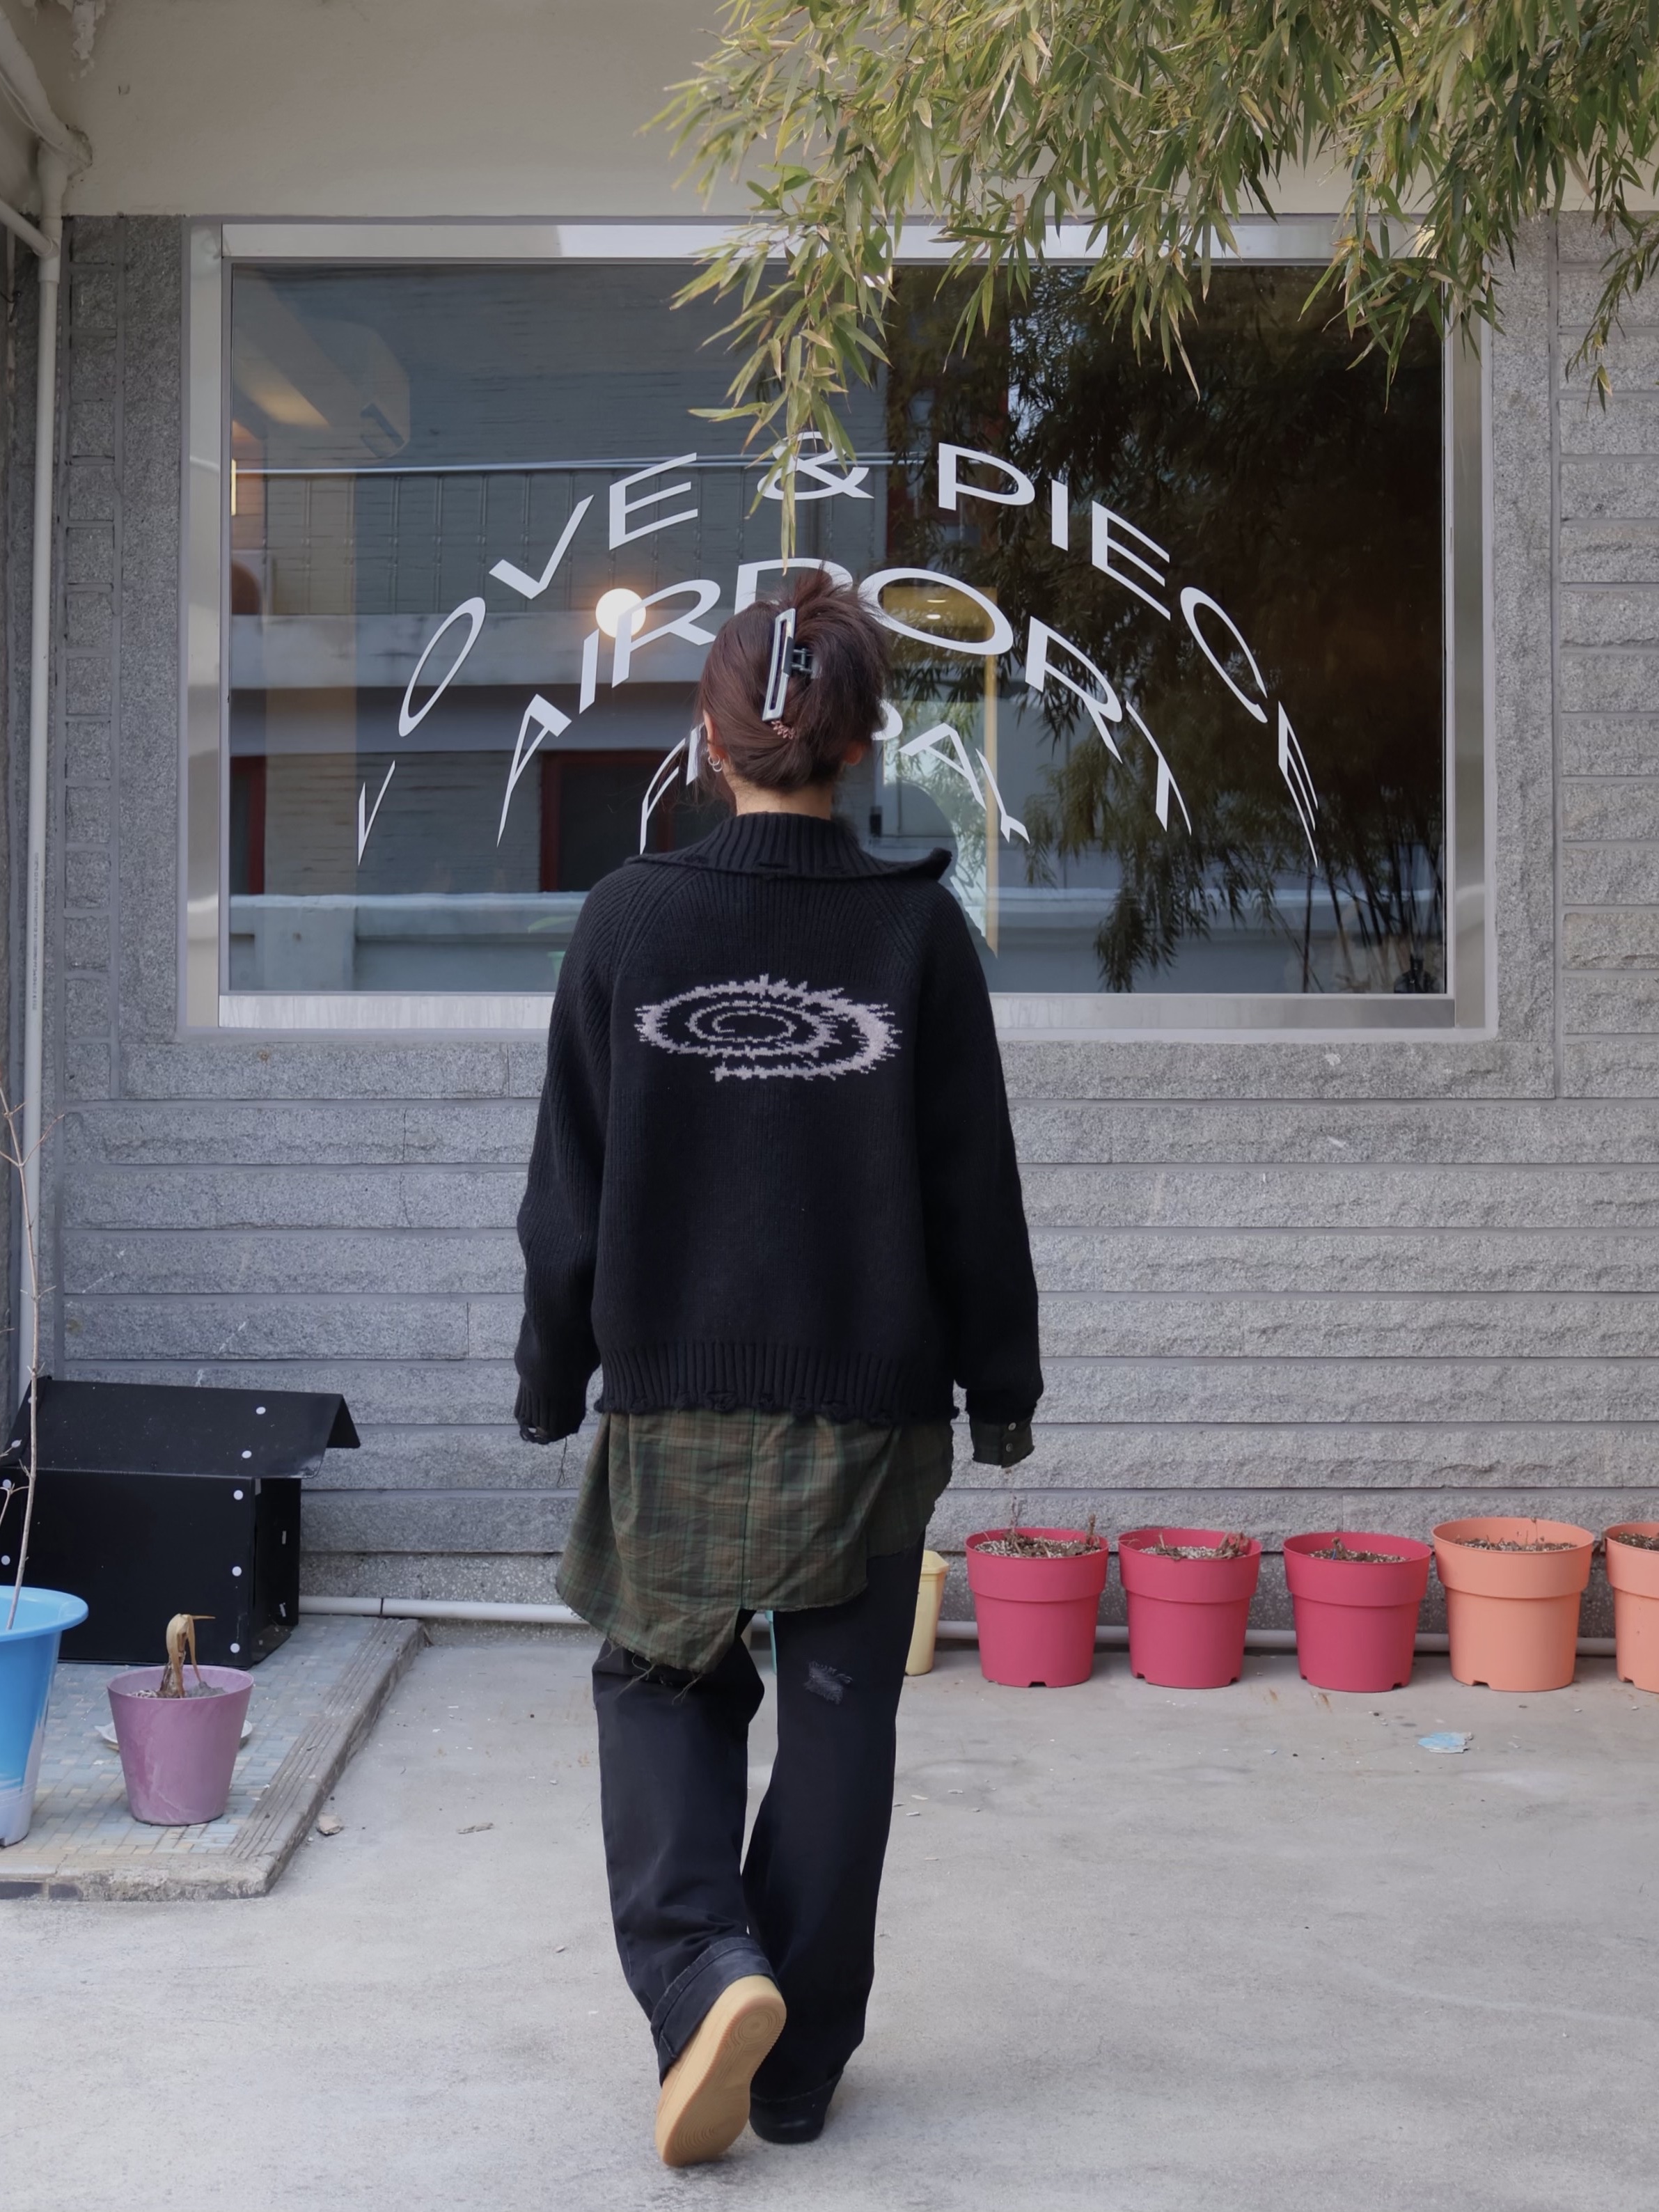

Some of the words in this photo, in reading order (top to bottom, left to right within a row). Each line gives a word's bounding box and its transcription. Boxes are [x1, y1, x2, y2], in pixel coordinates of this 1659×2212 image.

[359, 453, 698, 865] LOVE
[757, 431, 874, 500] &
[938, 443, 1318, 868] PIECE
[497, 558, 1192, 847] AIRPORT
